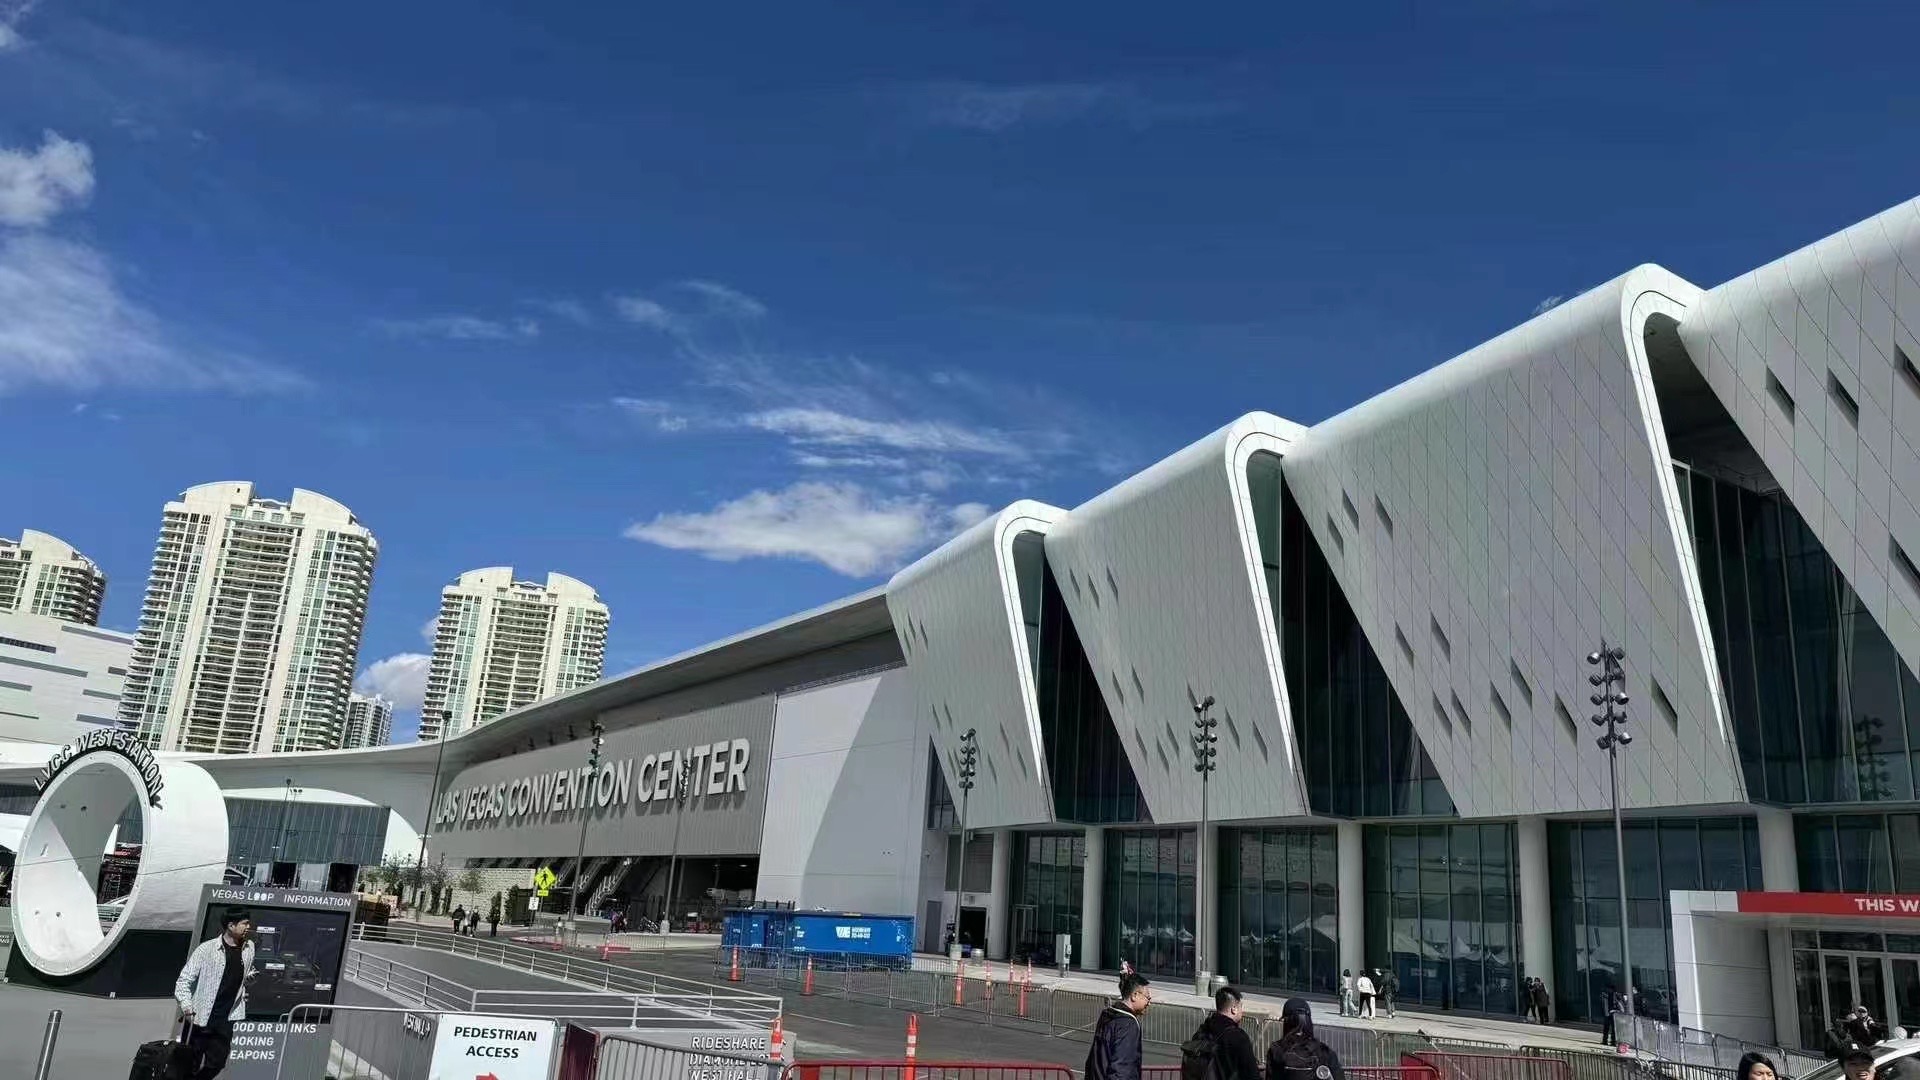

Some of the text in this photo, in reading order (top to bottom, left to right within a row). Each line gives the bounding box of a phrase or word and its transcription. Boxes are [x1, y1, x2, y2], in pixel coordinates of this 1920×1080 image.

[75, 728, 117, 752] WEST
[117, 731, 164, 798] STATION
[436, 738, 750, 824] LAS VEGAS CONVENTION CENTER
[211, 889, 245, 901] VEGAS
[283, 894, 352, 907] INFORMATION
[1854, 898, 1920, 913] THIS W
[232, 1022, 317, 1034] OOD OR DINKS
[453, 1026, 538, 1042] PEDESTRIAN
[231, 1036, 275, 1047] MOKING
[692, 1036, 766, 1050] RIDESHARE
[229, 1050, 276, 1061] EAPONS
[465, 1045, 520, 1059] ACCESS
